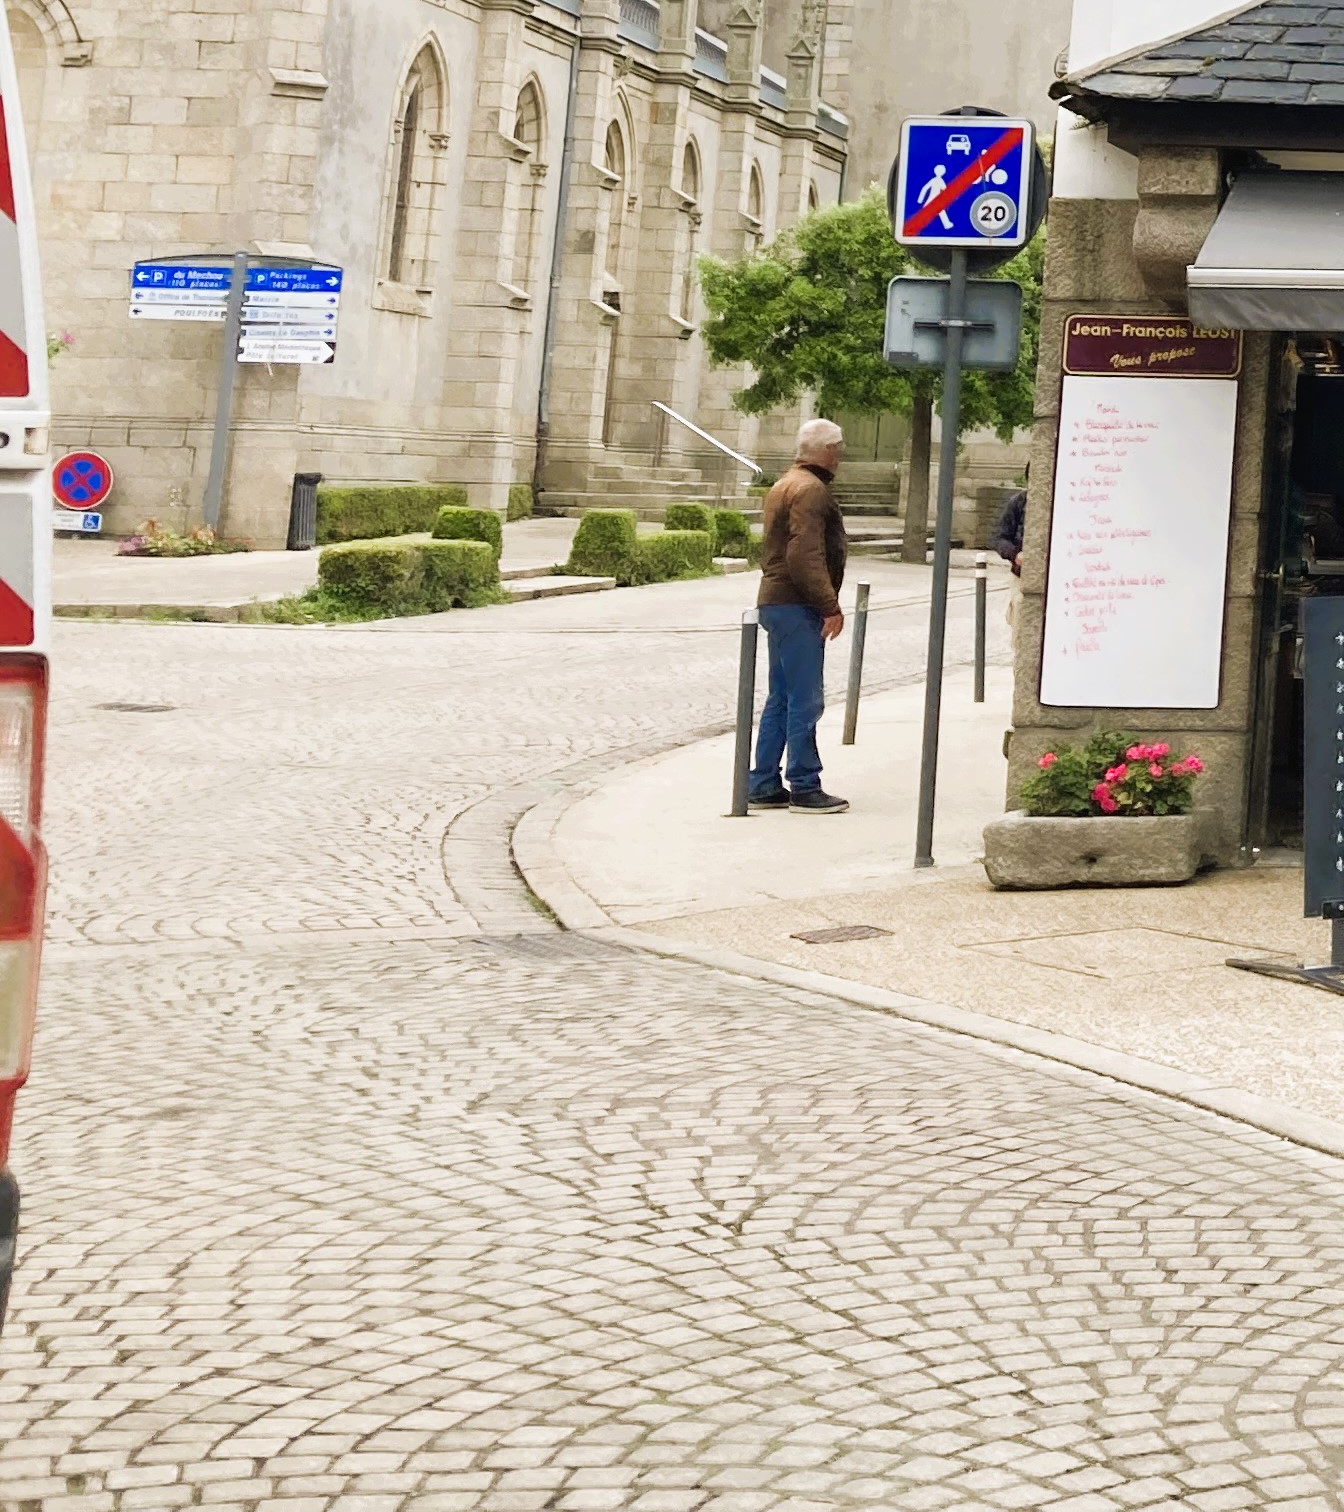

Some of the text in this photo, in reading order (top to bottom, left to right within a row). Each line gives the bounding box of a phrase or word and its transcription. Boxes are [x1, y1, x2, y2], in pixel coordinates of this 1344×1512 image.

[980, 205, 1006, 222] 20
[153, 271, 163, 283] P
[257, 274, 265, 284] P
[1071, 322, 1188, 340] Jean-François
[1110, 345, 1197, 369] Vous propose
